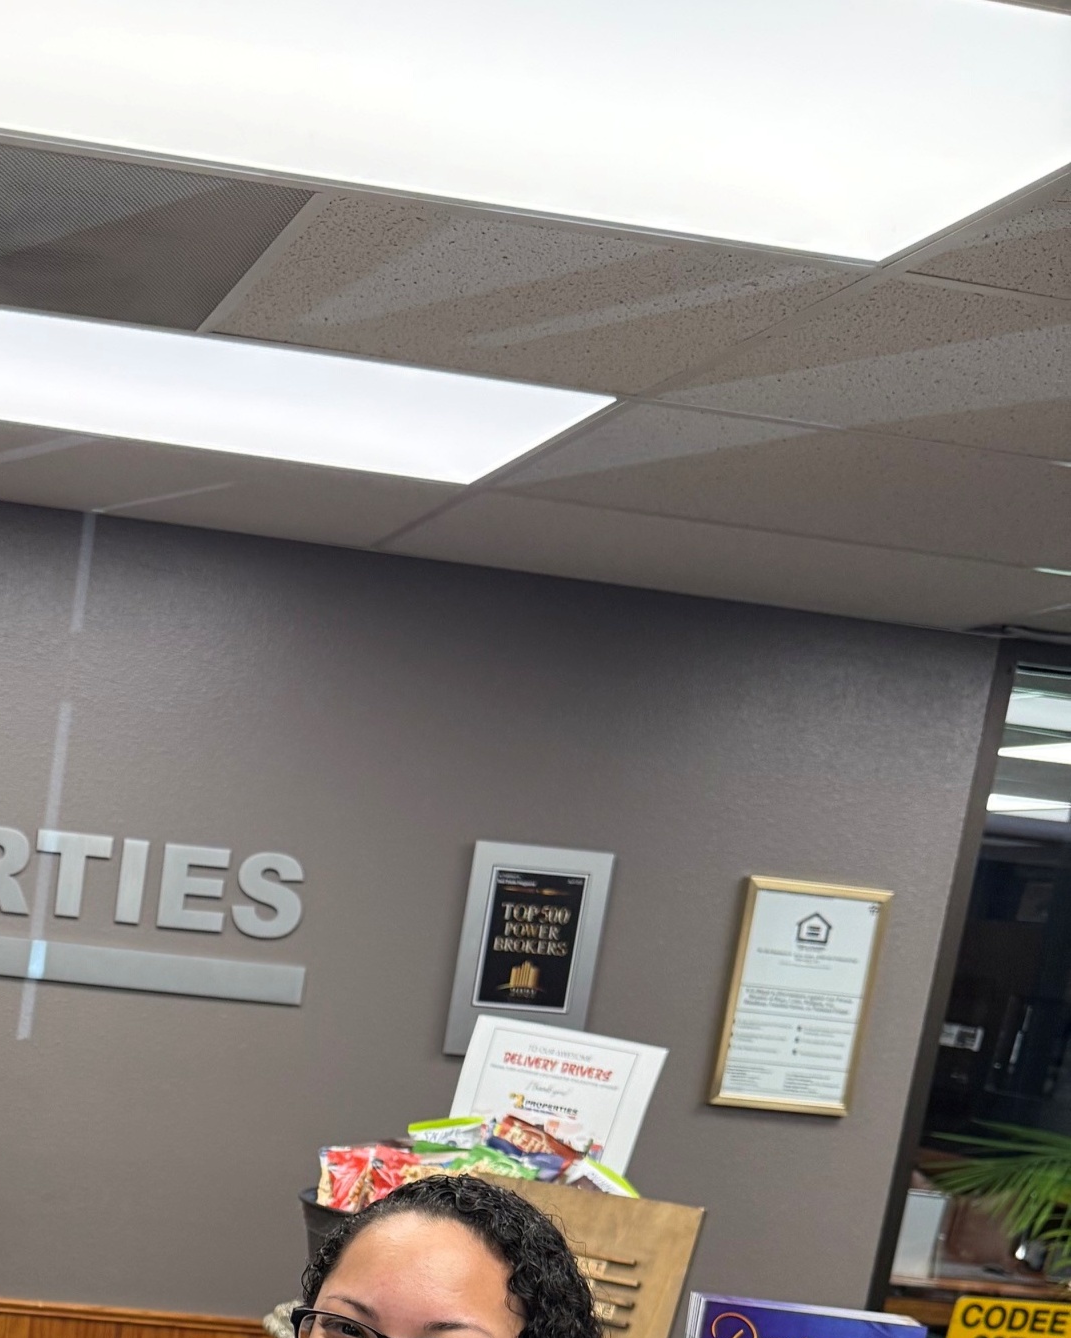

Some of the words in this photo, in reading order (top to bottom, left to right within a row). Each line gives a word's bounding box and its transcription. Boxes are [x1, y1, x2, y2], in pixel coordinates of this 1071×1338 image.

[502, 901, 540, 922] TOP
[539, 905, 571, 925] 500
[504, 921, 561, 940] POWER
[493, 936, 568, 957] BROKERS
[503, 1051, 559, 1073] DELIVERY
[561, 1061, 614, 1082] DRIVERS
[961, 1303, 1071, 1335] CODEE
